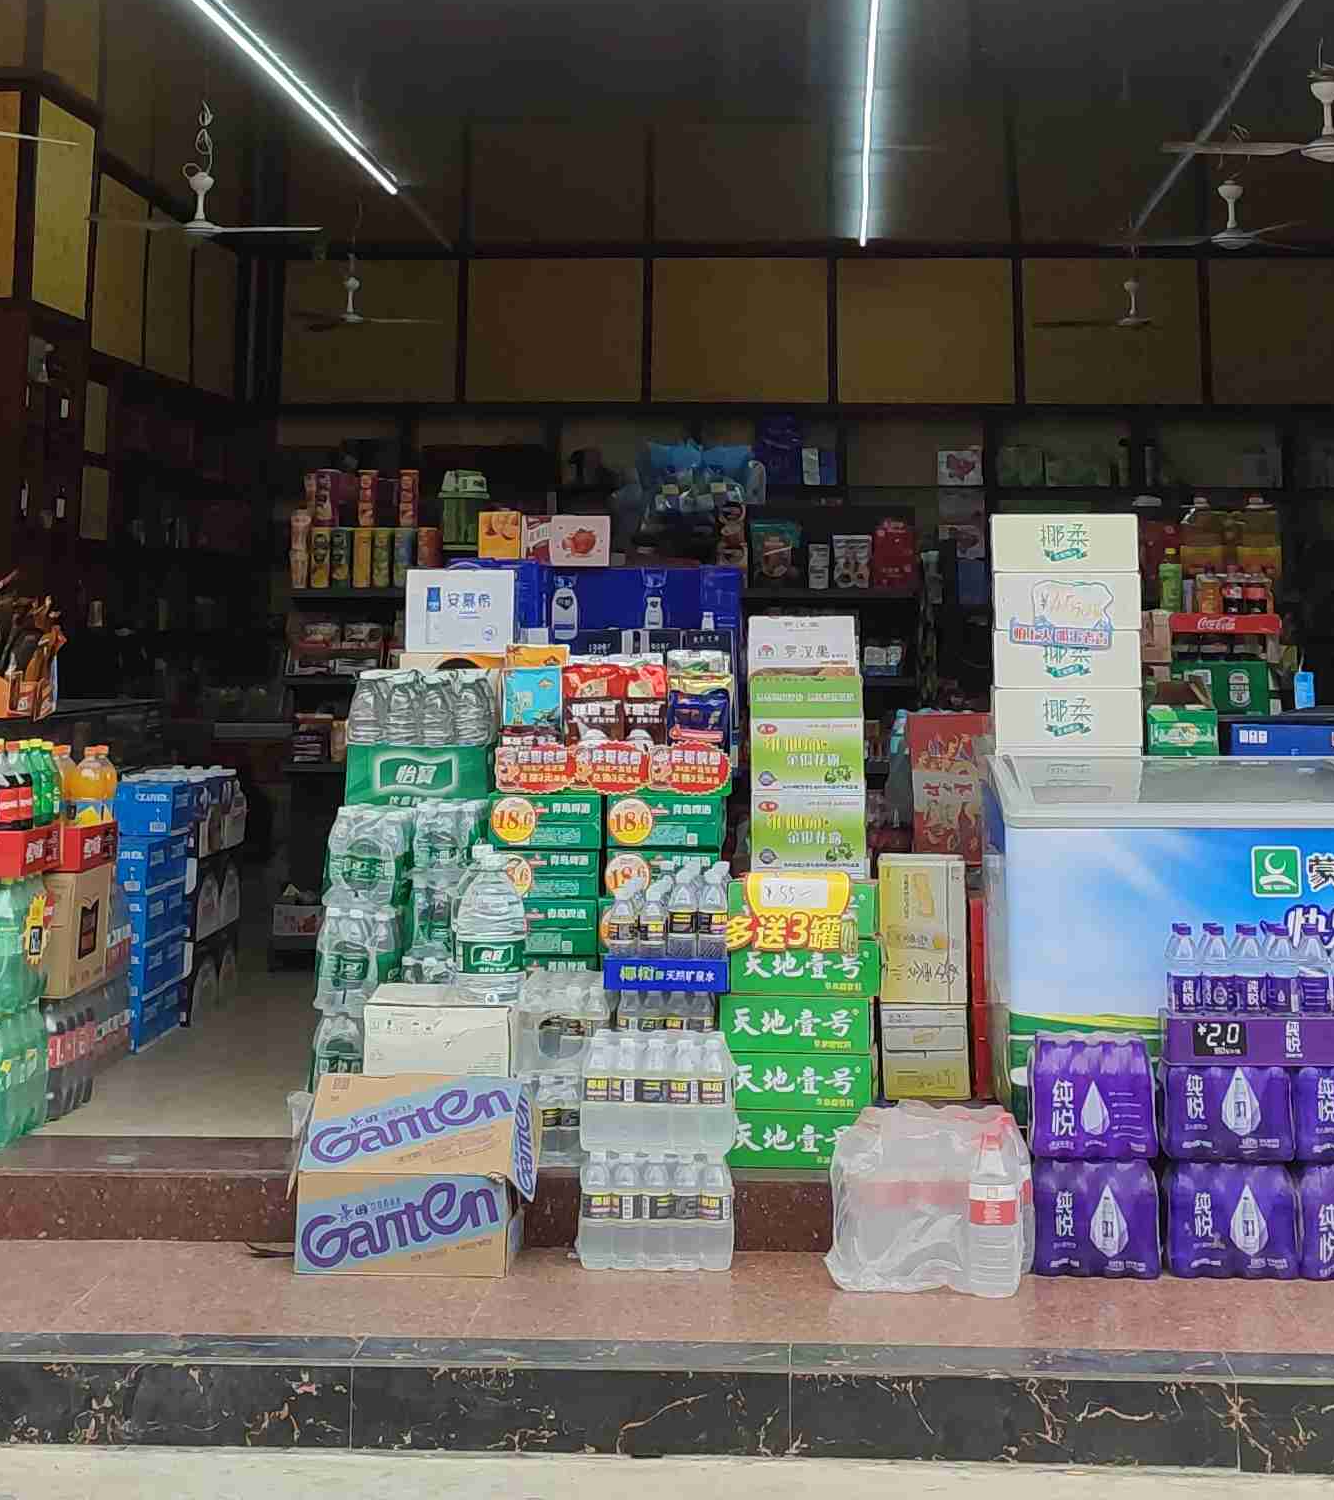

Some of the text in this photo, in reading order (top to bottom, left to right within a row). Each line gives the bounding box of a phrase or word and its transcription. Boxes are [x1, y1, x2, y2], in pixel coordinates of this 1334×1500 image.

[731, 1007, 853, 1038] 天地壹号
[1198, 1023, 1240, 1048] ¥2.0
[734, 1064, 856, 1096] 天地壹号
[1186, 1073, 1206, 1120] 纯悦
[1052, 1078, 1077, 1137] 纯悦
[1055, 1190, 1075, 1237] 纯悦
[1194, 1192, 1215, 1238] 纯悦
